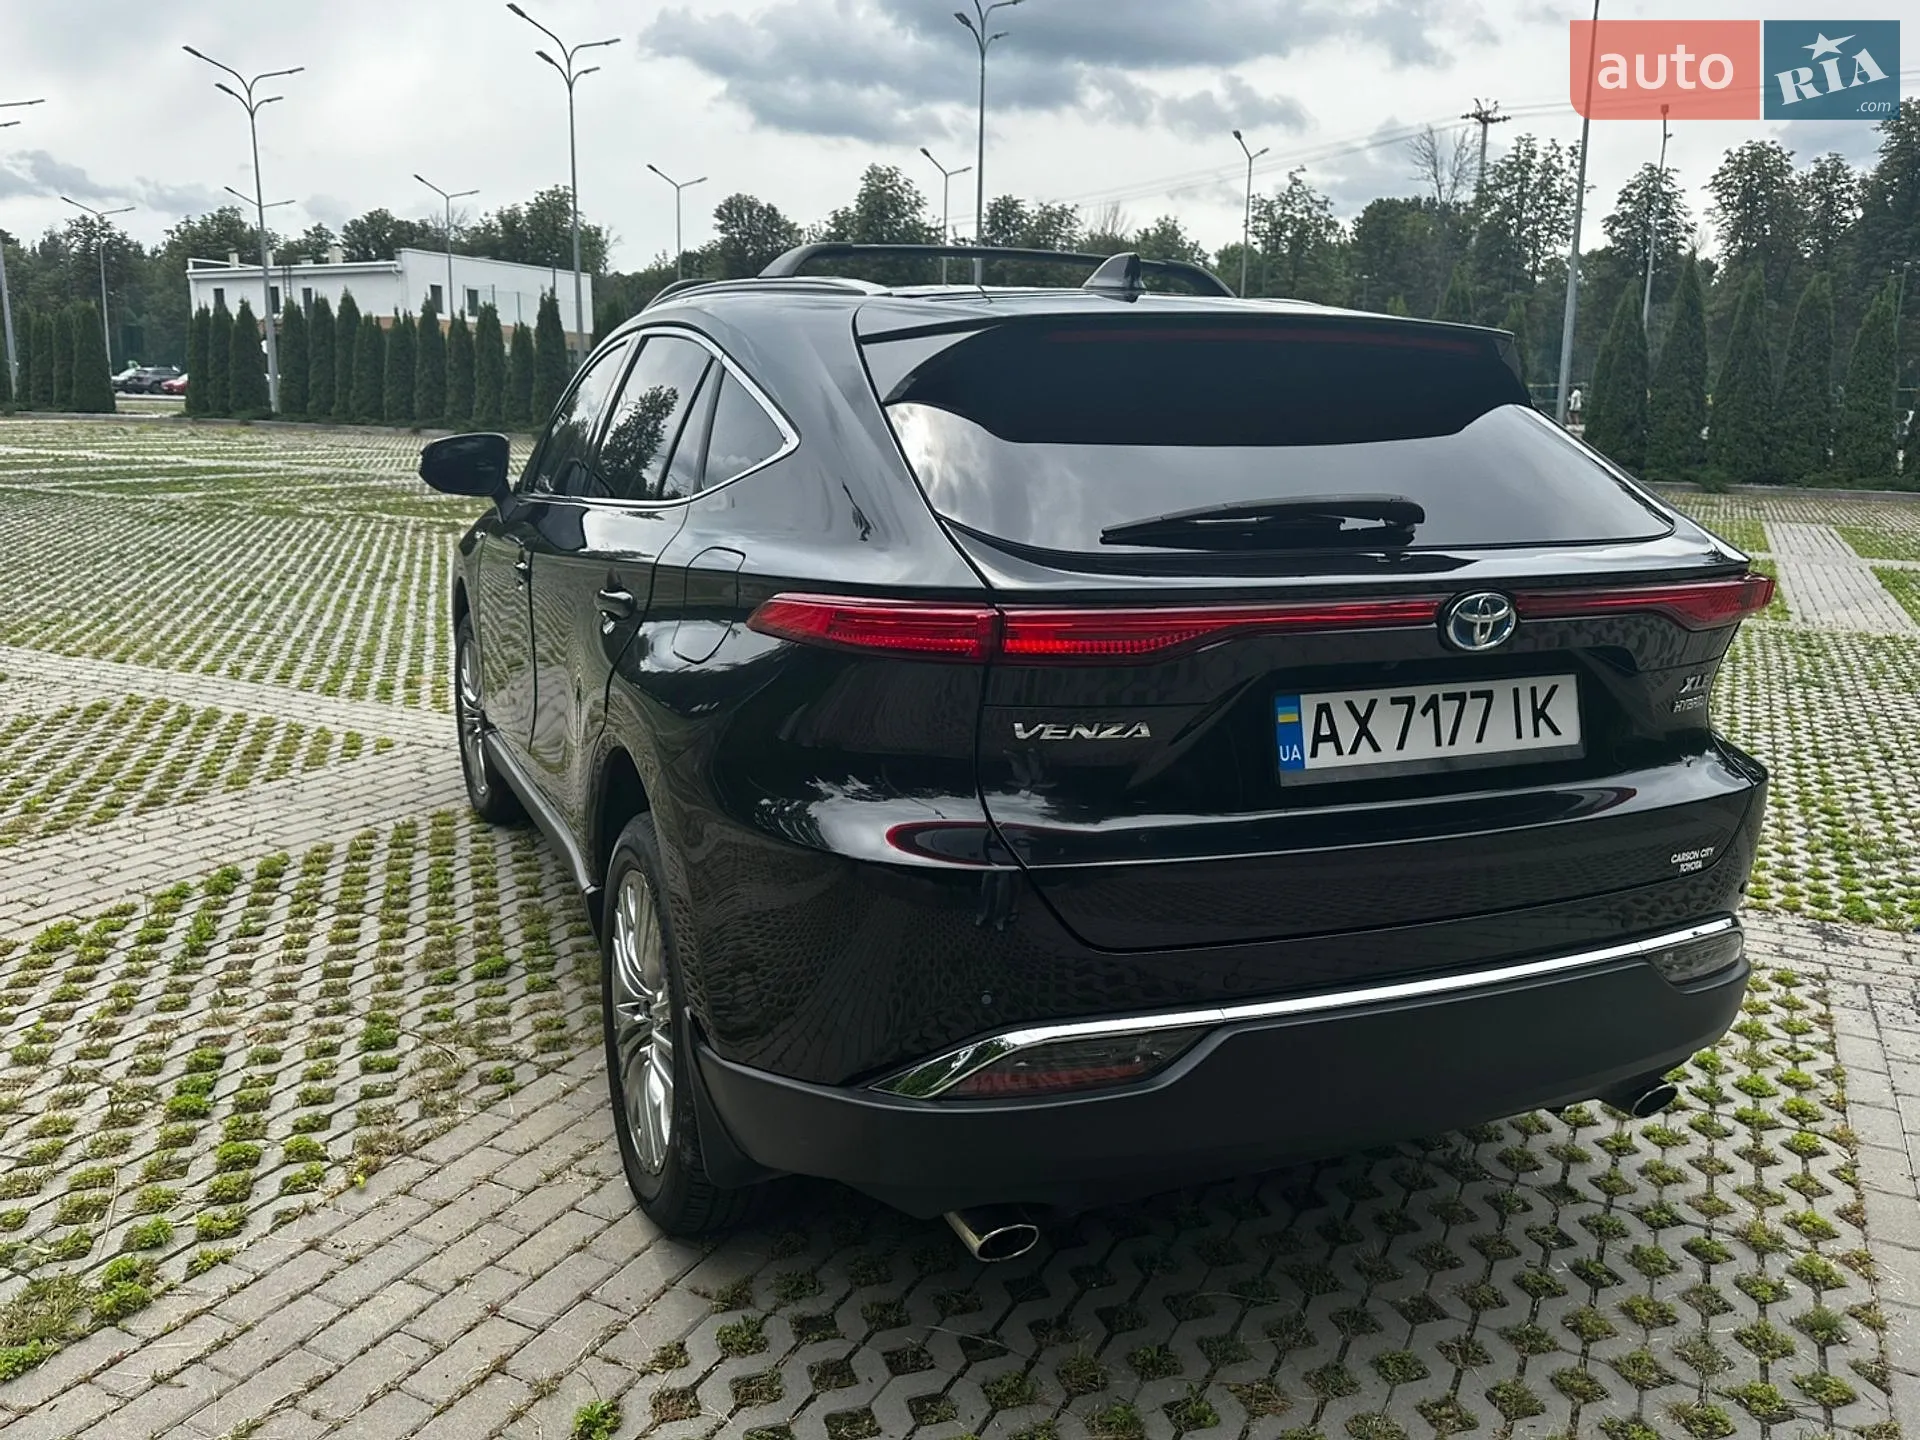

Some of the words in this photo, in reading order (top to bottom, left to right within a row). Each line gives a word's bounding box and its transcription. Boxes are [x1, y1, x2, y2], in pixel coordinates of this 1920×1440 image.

[1310, 698, 1382, 758] AX
[1390, 689, 1494, 751] 7177
[1513, 684, 1562, 739] IK
[1013, 722, 1151, 740] VENZA
[1279, 744, 1302, 762] UA
[1670, 850, 1700, 864] CARSON
[1700, 846, 1715, 858] CITY
